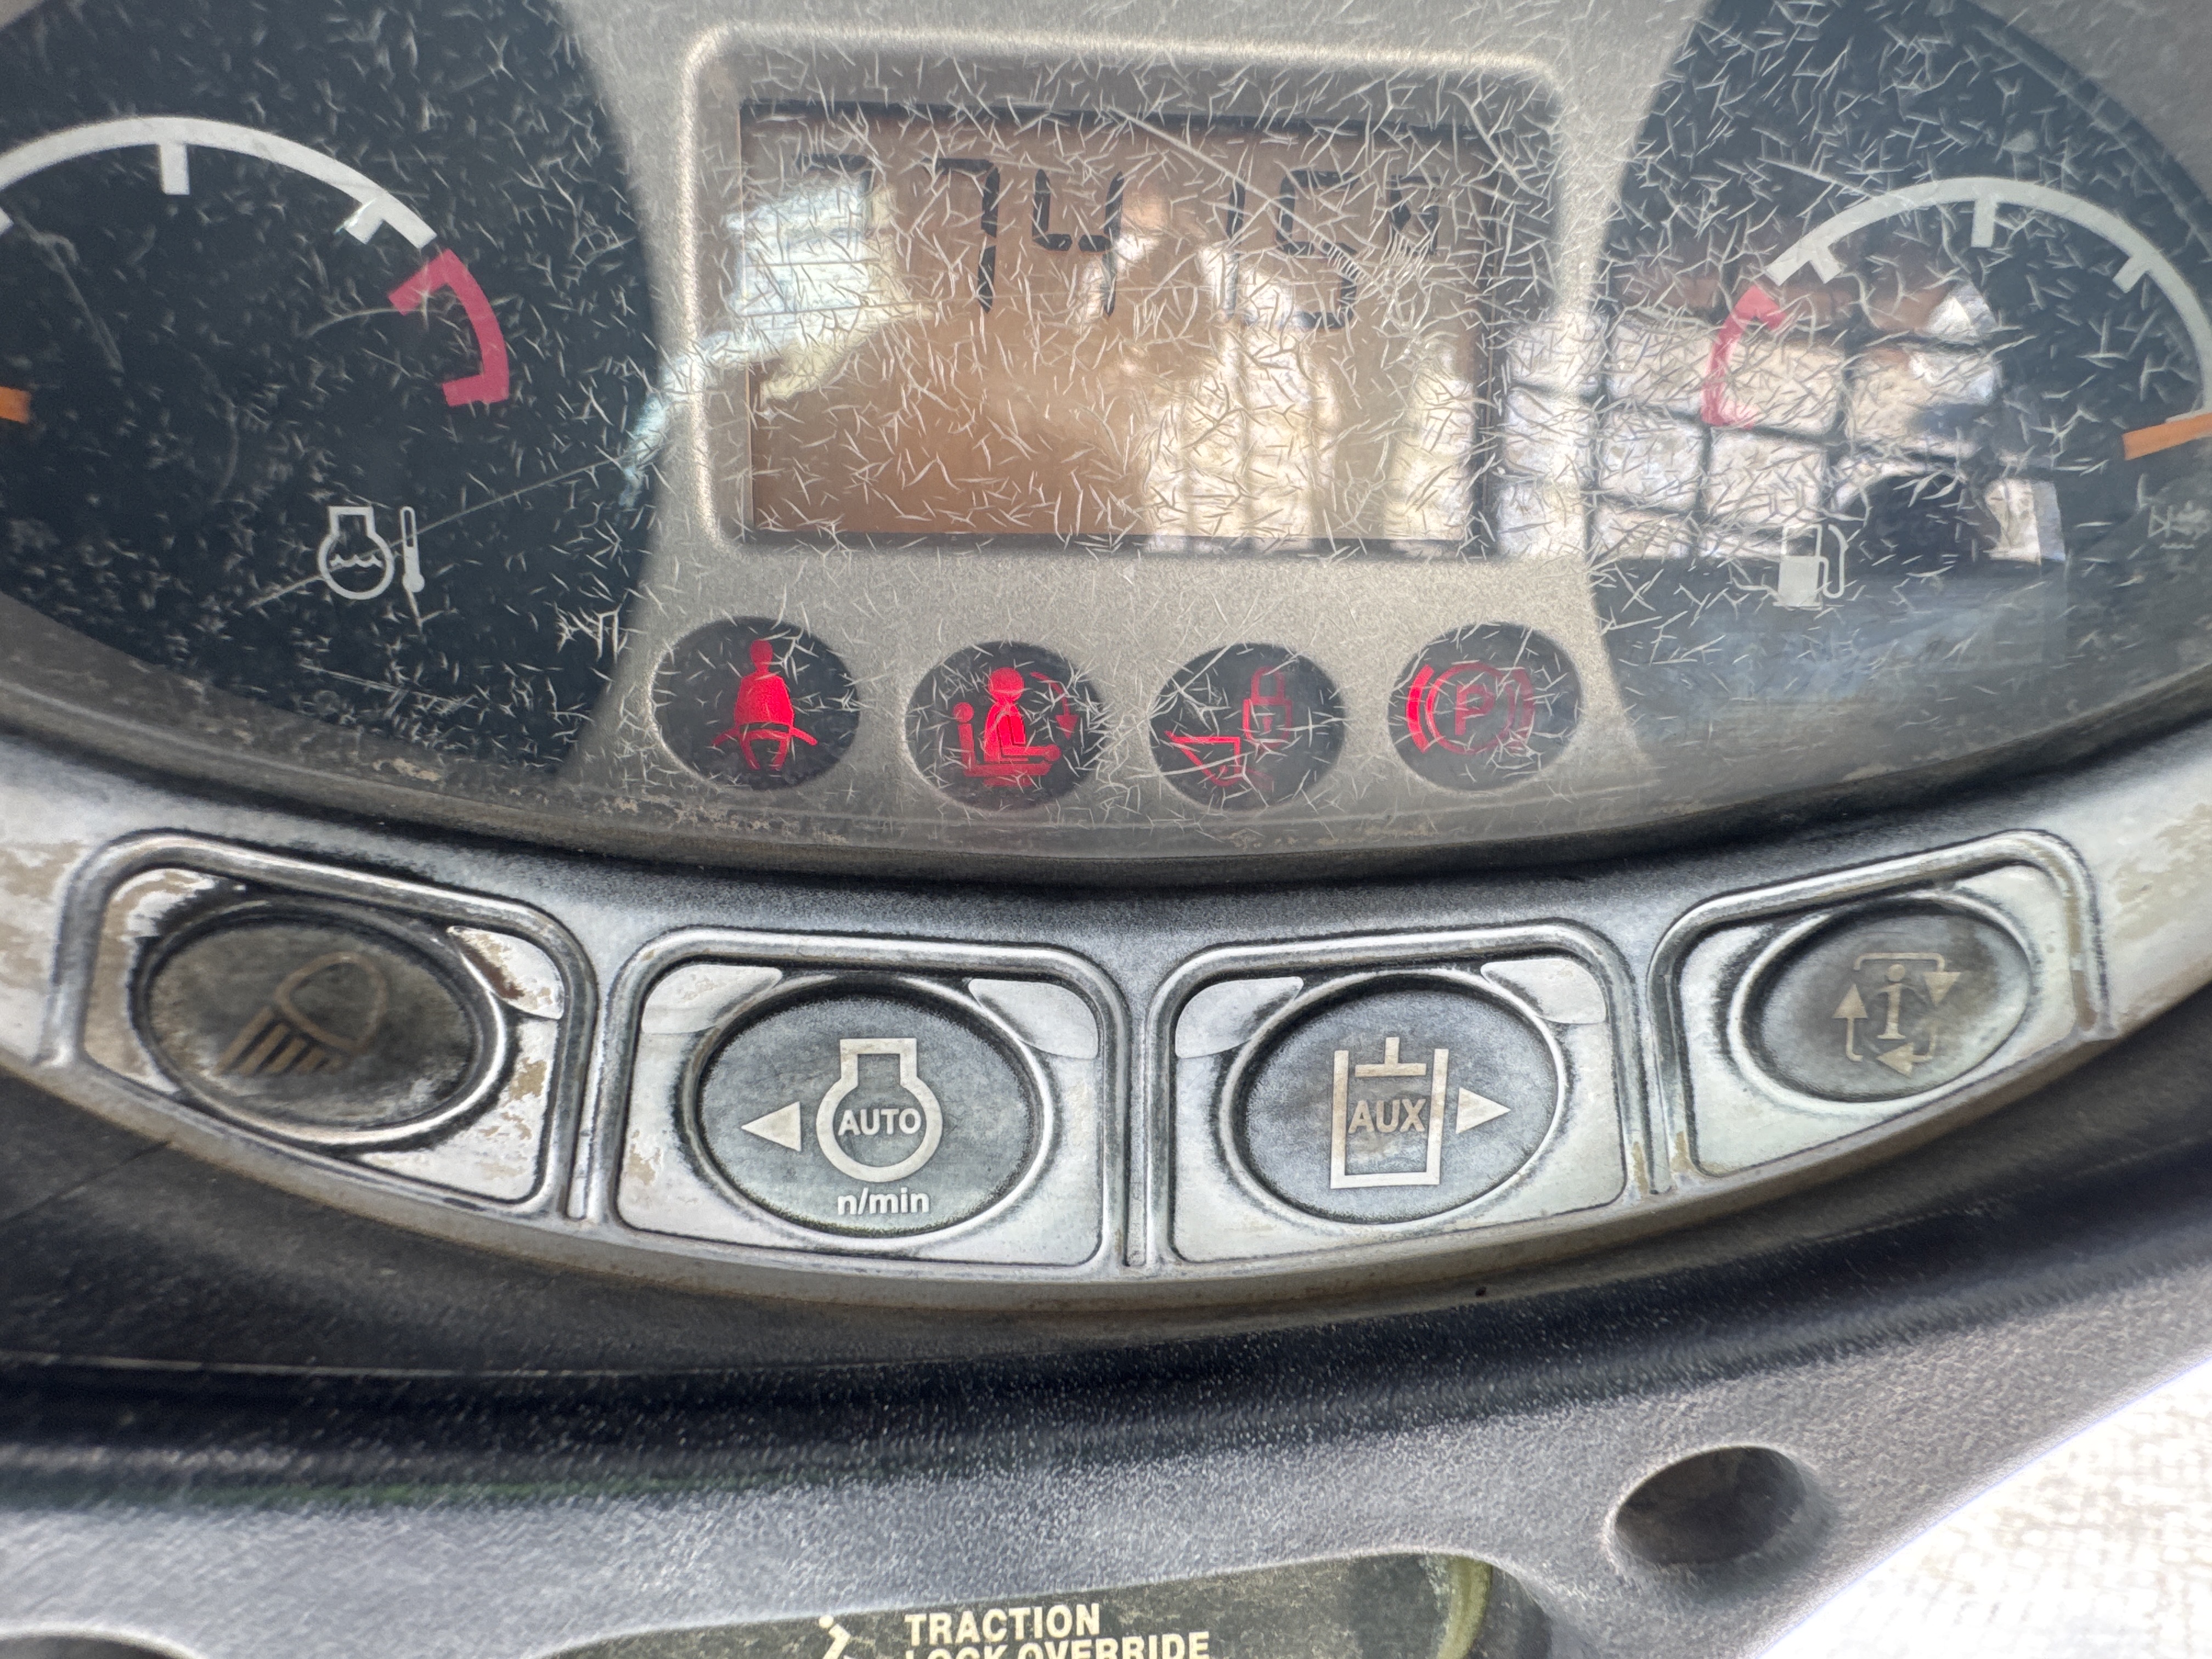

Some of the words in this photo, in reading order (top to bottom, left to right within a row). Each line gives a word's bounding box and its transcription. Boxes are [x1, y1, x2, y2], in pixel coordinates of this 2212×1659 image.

[838, 1108, 922, 1136] AUTO
[1347, 1098, 1426, 1133] AUX
[837, 1187, 930, 1215] n/min
[904, 1602, 1099, 1646] TRACTION
